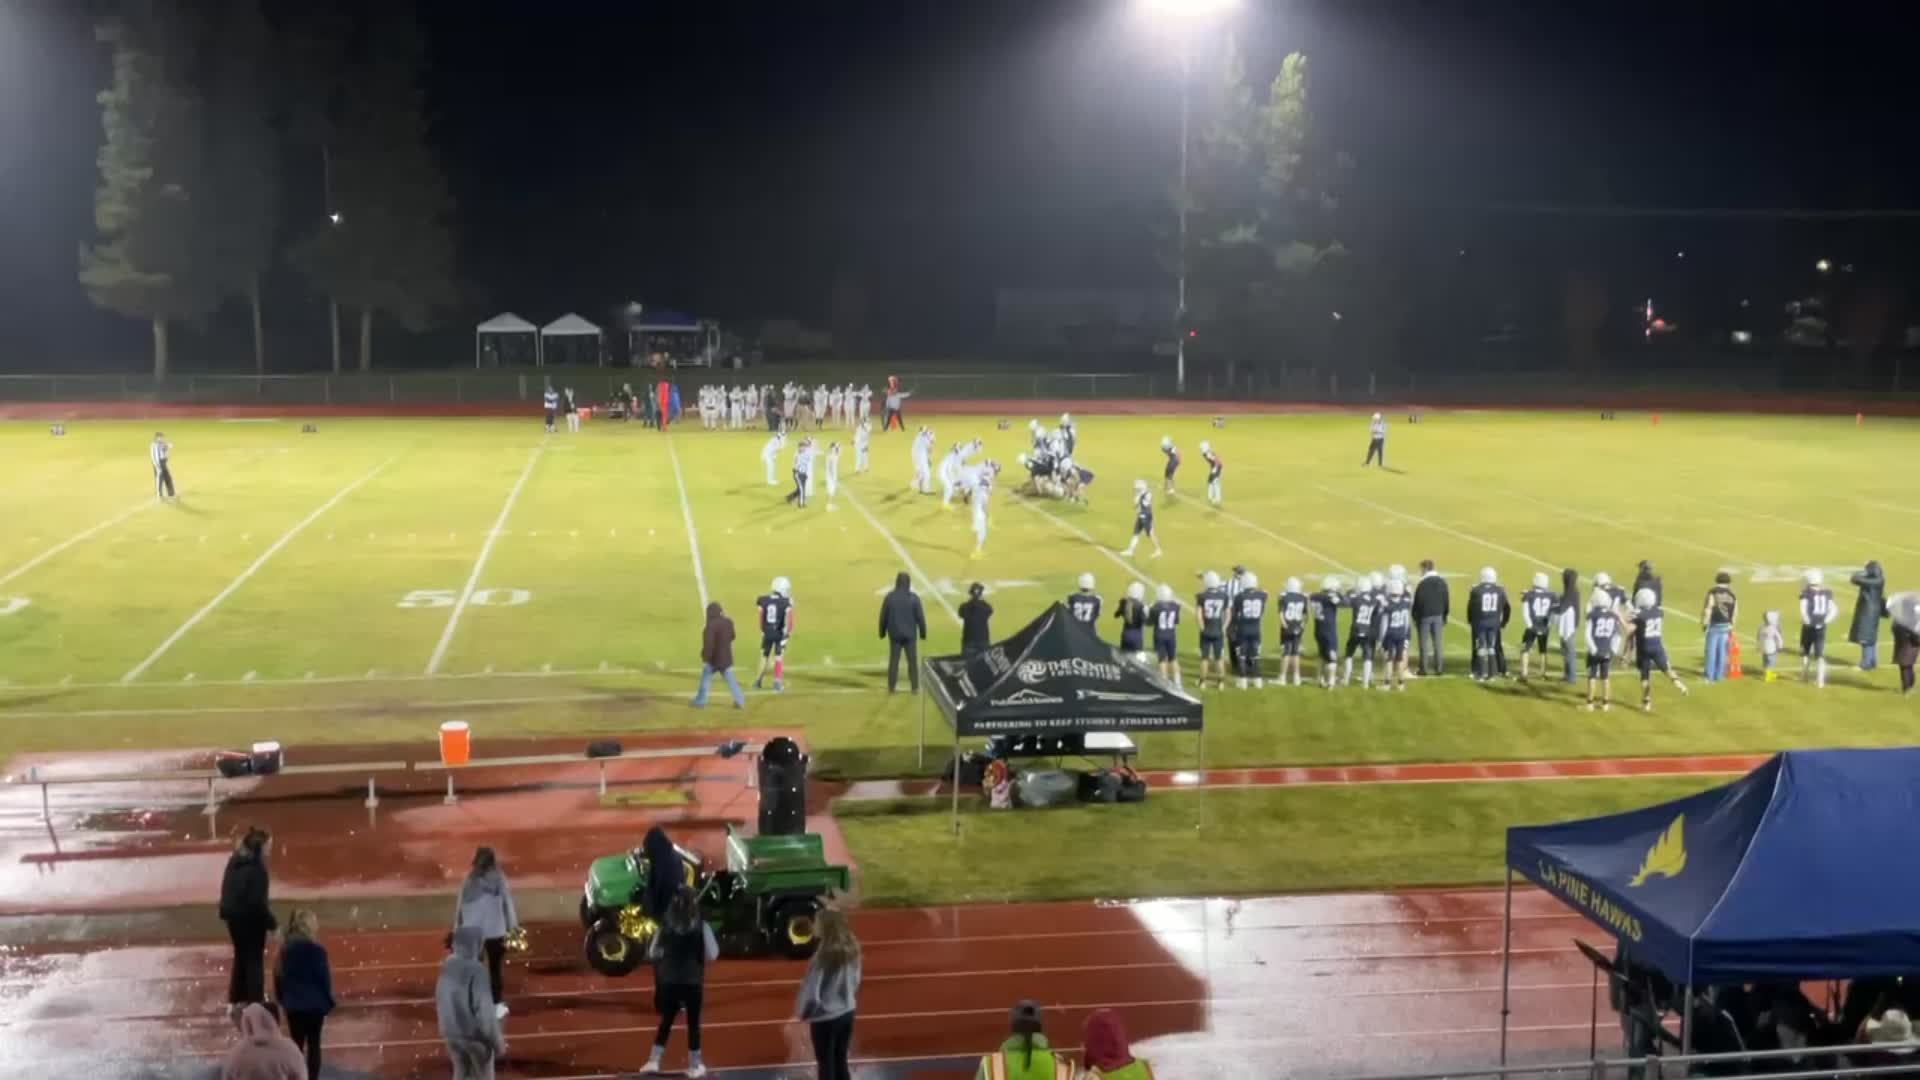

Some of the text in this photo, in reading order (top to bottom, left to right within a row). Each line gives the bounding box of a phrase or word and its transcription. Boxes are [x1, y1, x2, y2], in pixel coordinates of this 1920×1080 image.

[396, 588, 529, 608] 50
[1533, 597, 1551, 616] 42
[1813, 594, 1827, 615] 11
[1204, 599, 1224, 619] 57
[1034, 719, 1048, 727] TO
[1049, 718, 1073, 727] KEEP
[1538, 860, 1642, 942] LA PINE HAWKS
